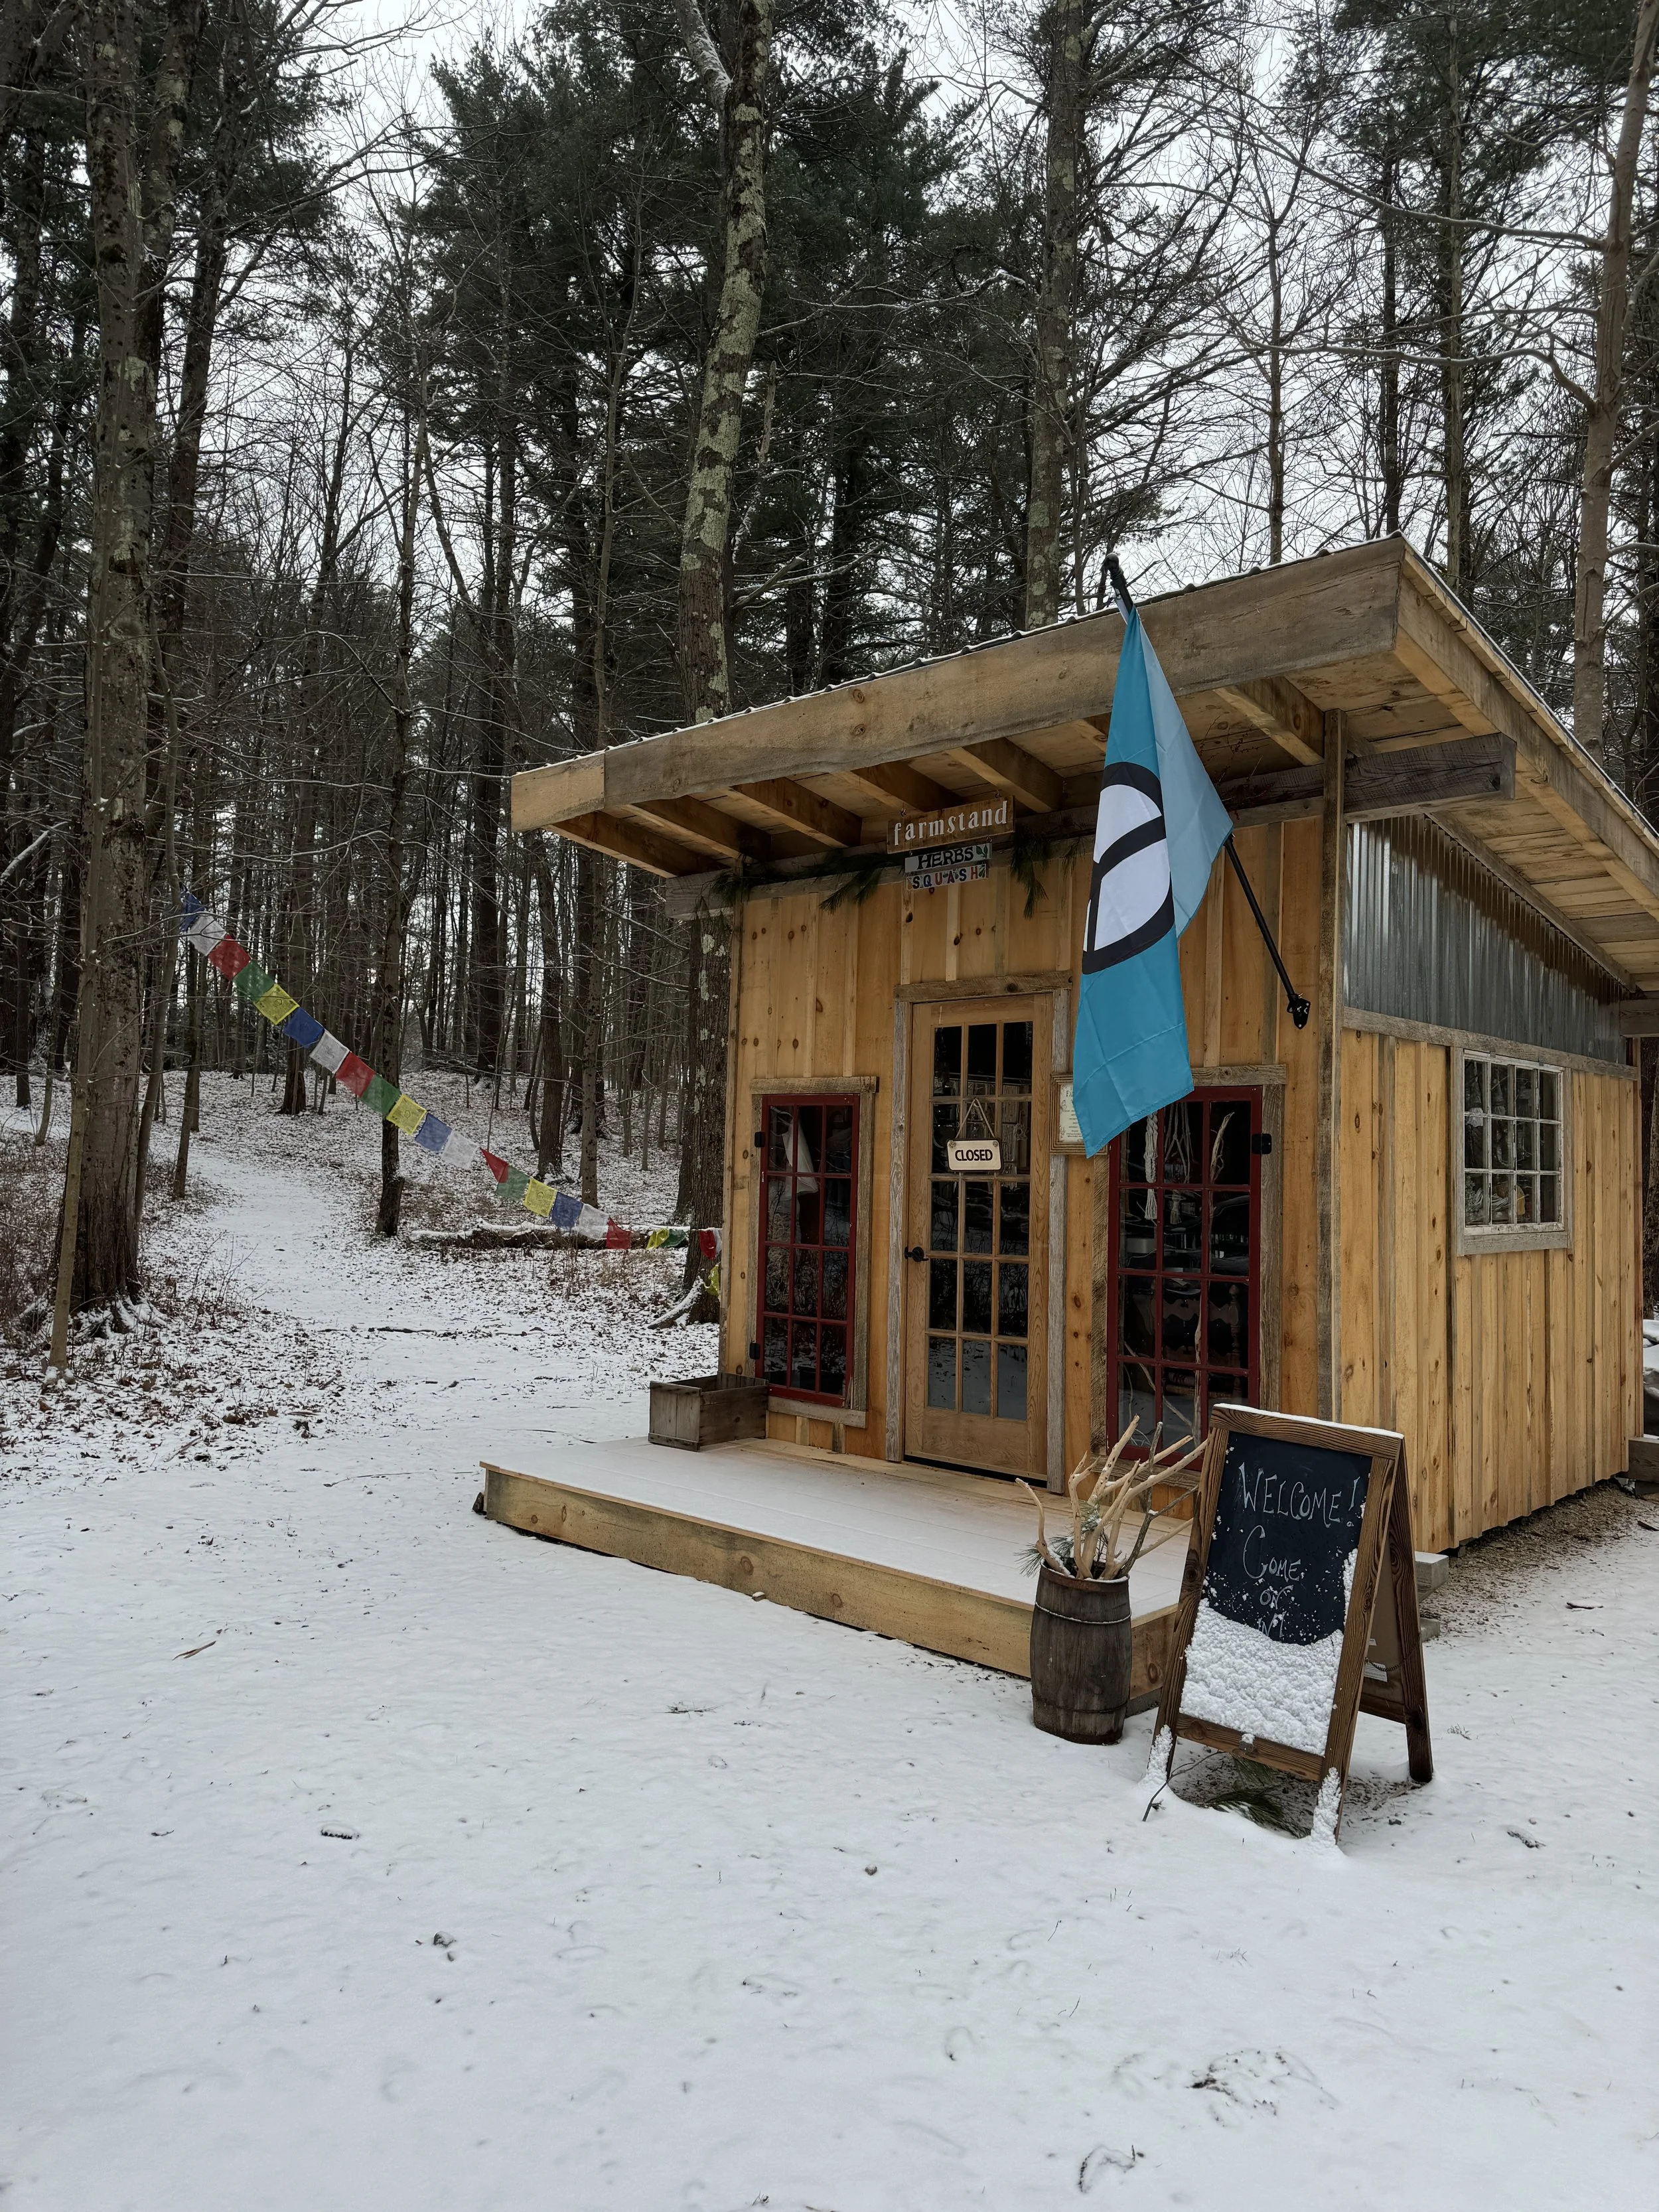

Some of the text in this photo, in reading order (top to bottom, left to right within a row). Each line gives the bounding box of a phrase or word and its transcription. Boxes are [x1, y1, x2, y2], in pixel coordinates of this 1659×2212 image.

[894, 800, 1007, 846] farmstand
[916, 846, 974, 869] HERBS
[912, 866, 978, 889] SQUASH
[955, 1149, 993, 1161] CLOSED
[1260, 1585, 1293, 1610] ON
